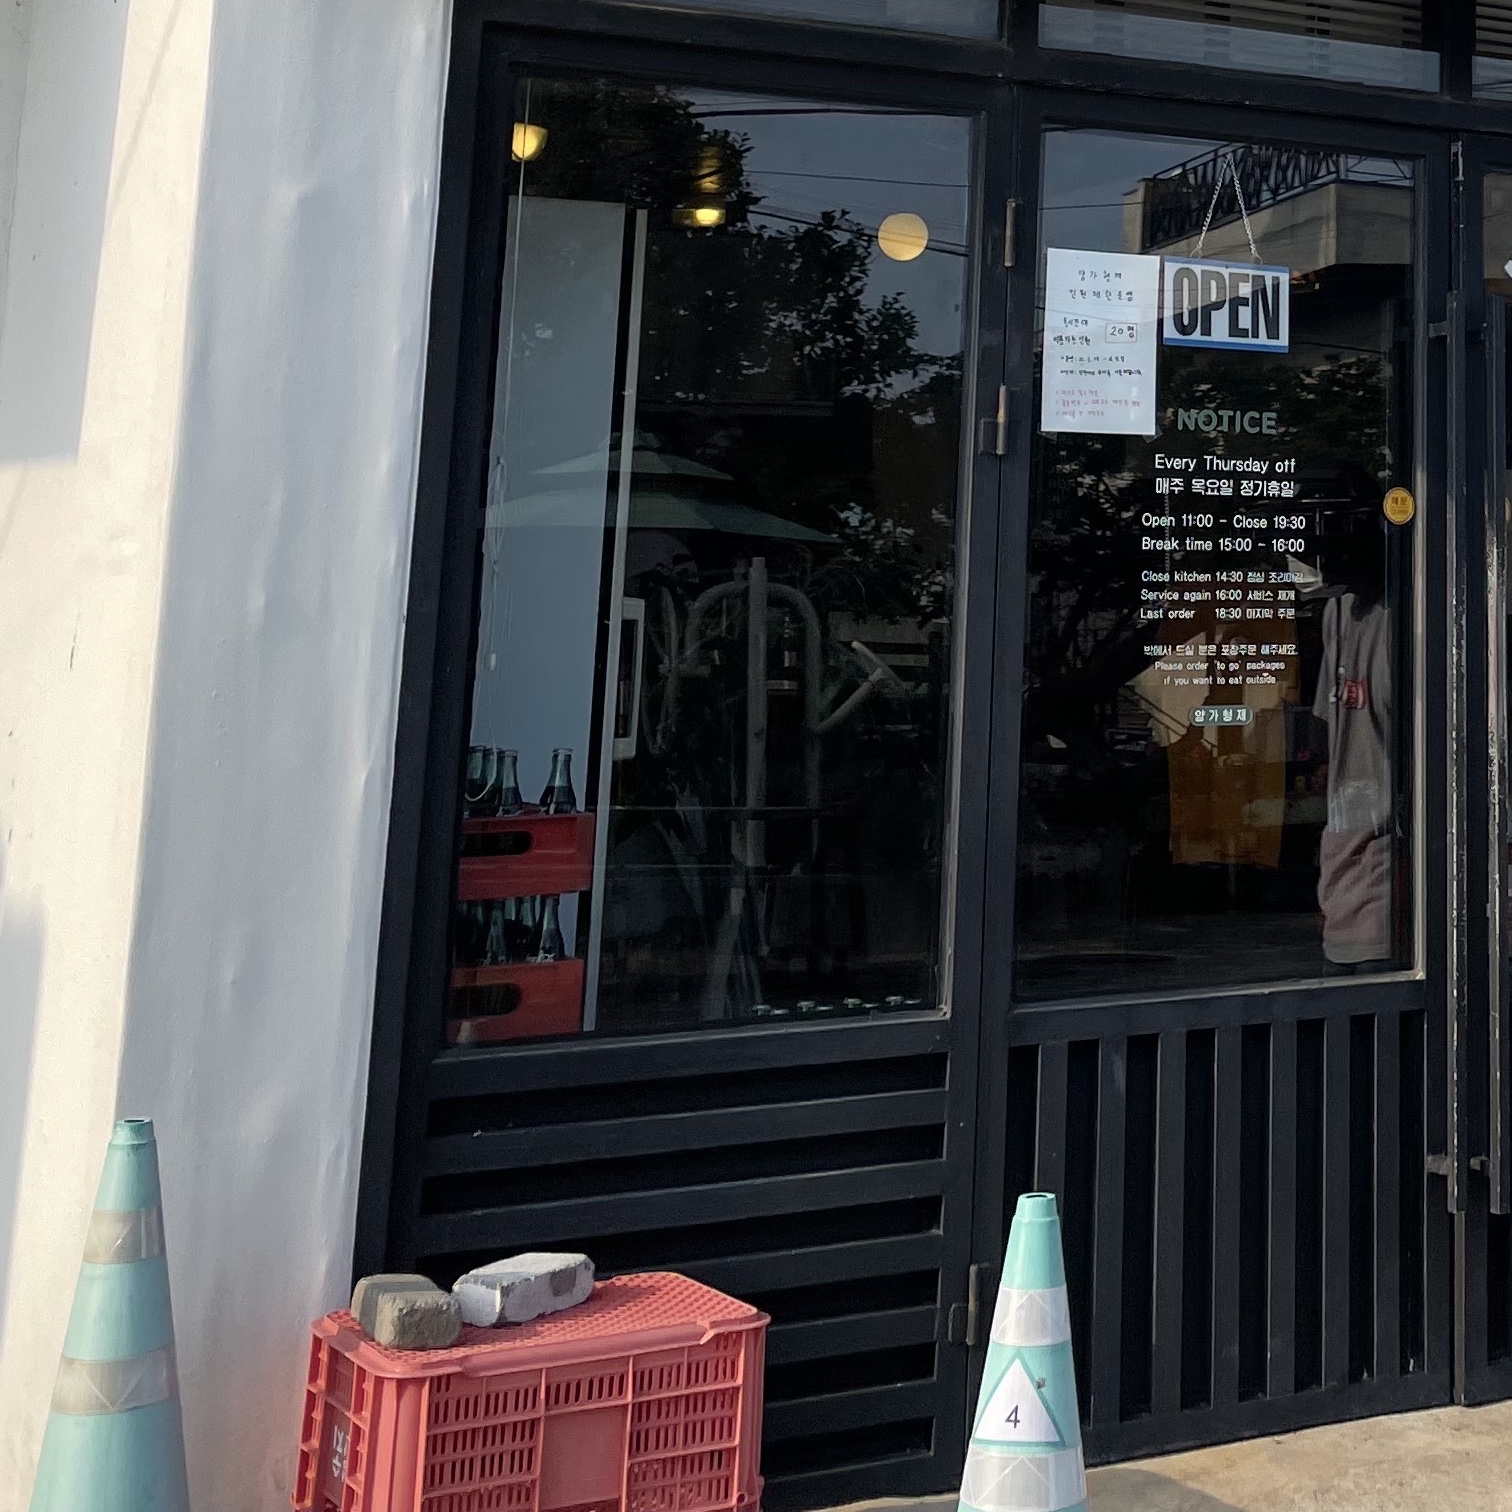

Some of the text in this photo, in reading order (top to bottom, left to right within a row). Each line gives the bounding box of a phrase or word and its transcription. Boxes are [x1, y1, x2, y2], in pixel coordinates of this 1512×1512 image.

[1173, 267, 1280, 340] OPEN
[1177, 408, 1277, 435] NOTICE
[1155, 453, 1296, 474] Every Thursday off
[1155, 478, 1294, 498] 매주 목요일 정기휴일
[1141, 513, 1176, 528] Open
[1181, 513, 1213, 527] 11:00
[1233, 515, 1268, 528] Close
[1273, 515, 1306, 529] 19:30
[1141, 537, 1179, 551] Break
[1185, 537, 1213, 551] time
[1219, 538, 1252, 551] 15:00
[1272, 539, 1305, 552] 16:00
[1141, 571, 1170, 582] Close
[1174, 570, 1212, 582] kitchen
[1215, 571, 1243, 582] 14:30
[1247, 571, 1265, 583] 점심
[1140, 589, 1179, 601] Service
[1183, 589, 1211, 602] again
[1215, 590, 1242, 601] 16:00
[1247, 590, 1273, 601] 서비스
[1140, 608, 1295, 620] Last order 18:30 마지막 주문
[1175, 645, 1194, 656] 드실
[1154, 661, 1182, 671] Please
[1186, 661, 1209, 671] order
[1163, 674, 1276, 686] if you want to eat outside
[1194, 709, 1247, 722] 양가형제
[1005, 1404, 1020, 1430] 4
